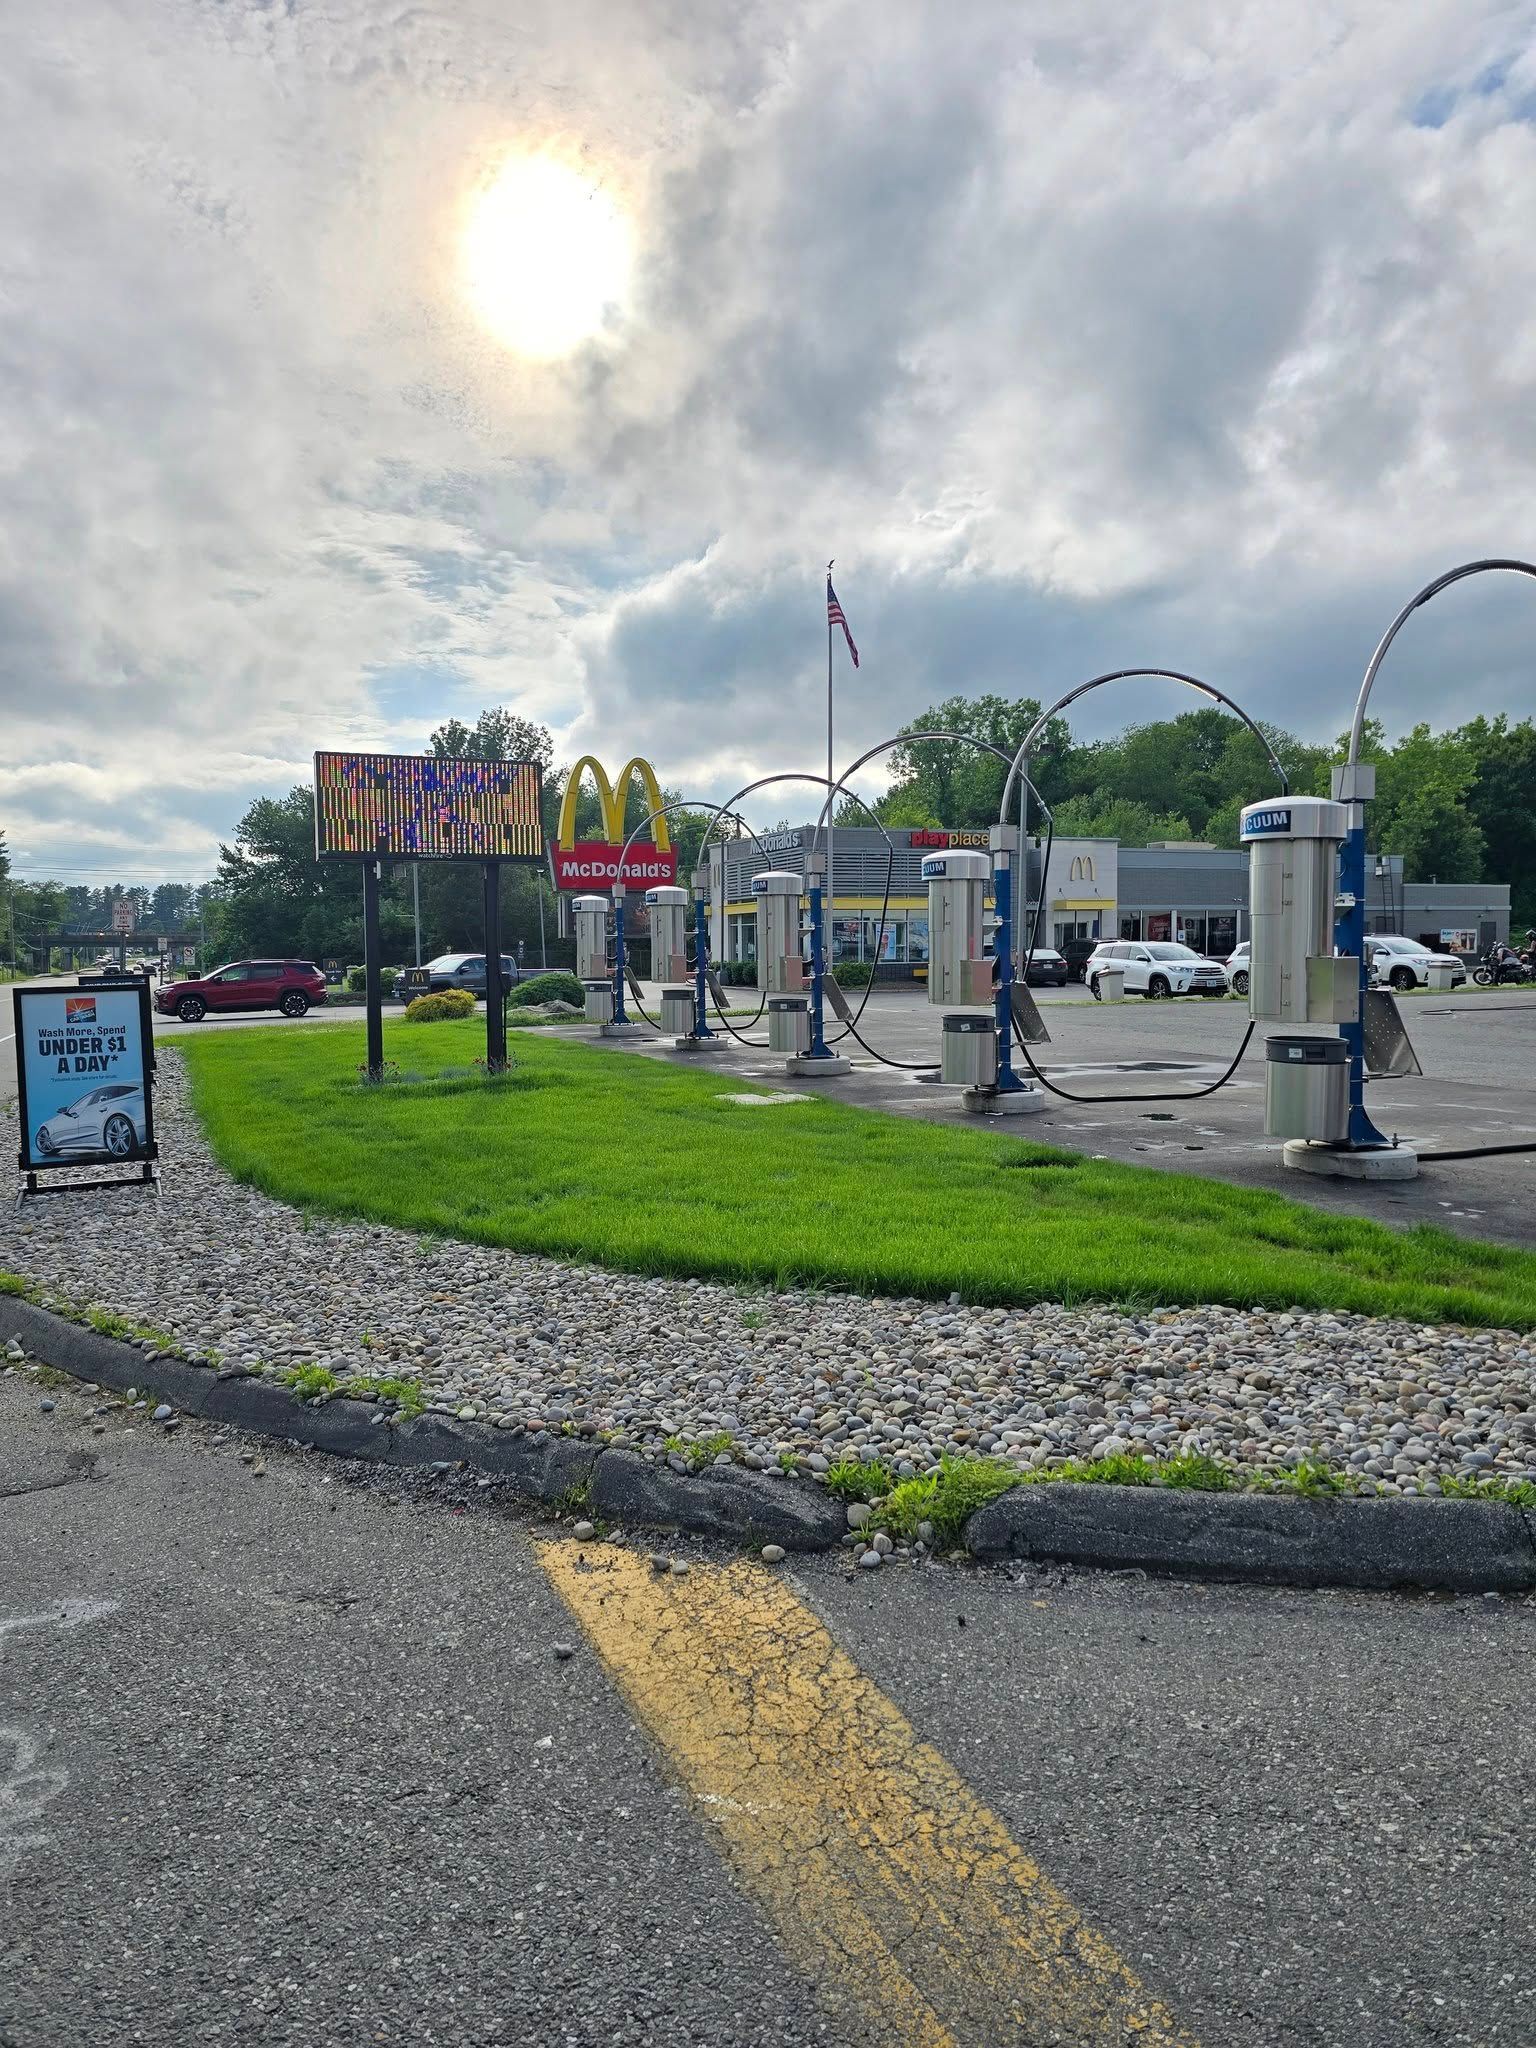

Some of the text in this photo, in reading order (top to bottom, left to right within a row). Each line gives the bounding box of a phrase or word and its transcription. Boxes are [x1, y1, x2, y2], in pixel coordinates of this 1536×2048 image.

[1244, 811, 1288, 831] CUUM
[562, 861, 672, 878] McDonald's
[38, 1025, 126, 1037] Wash More, Spend
[38, 1036, 127, 1056] UNDER $1
[57, 1057, 70, 1074] A
